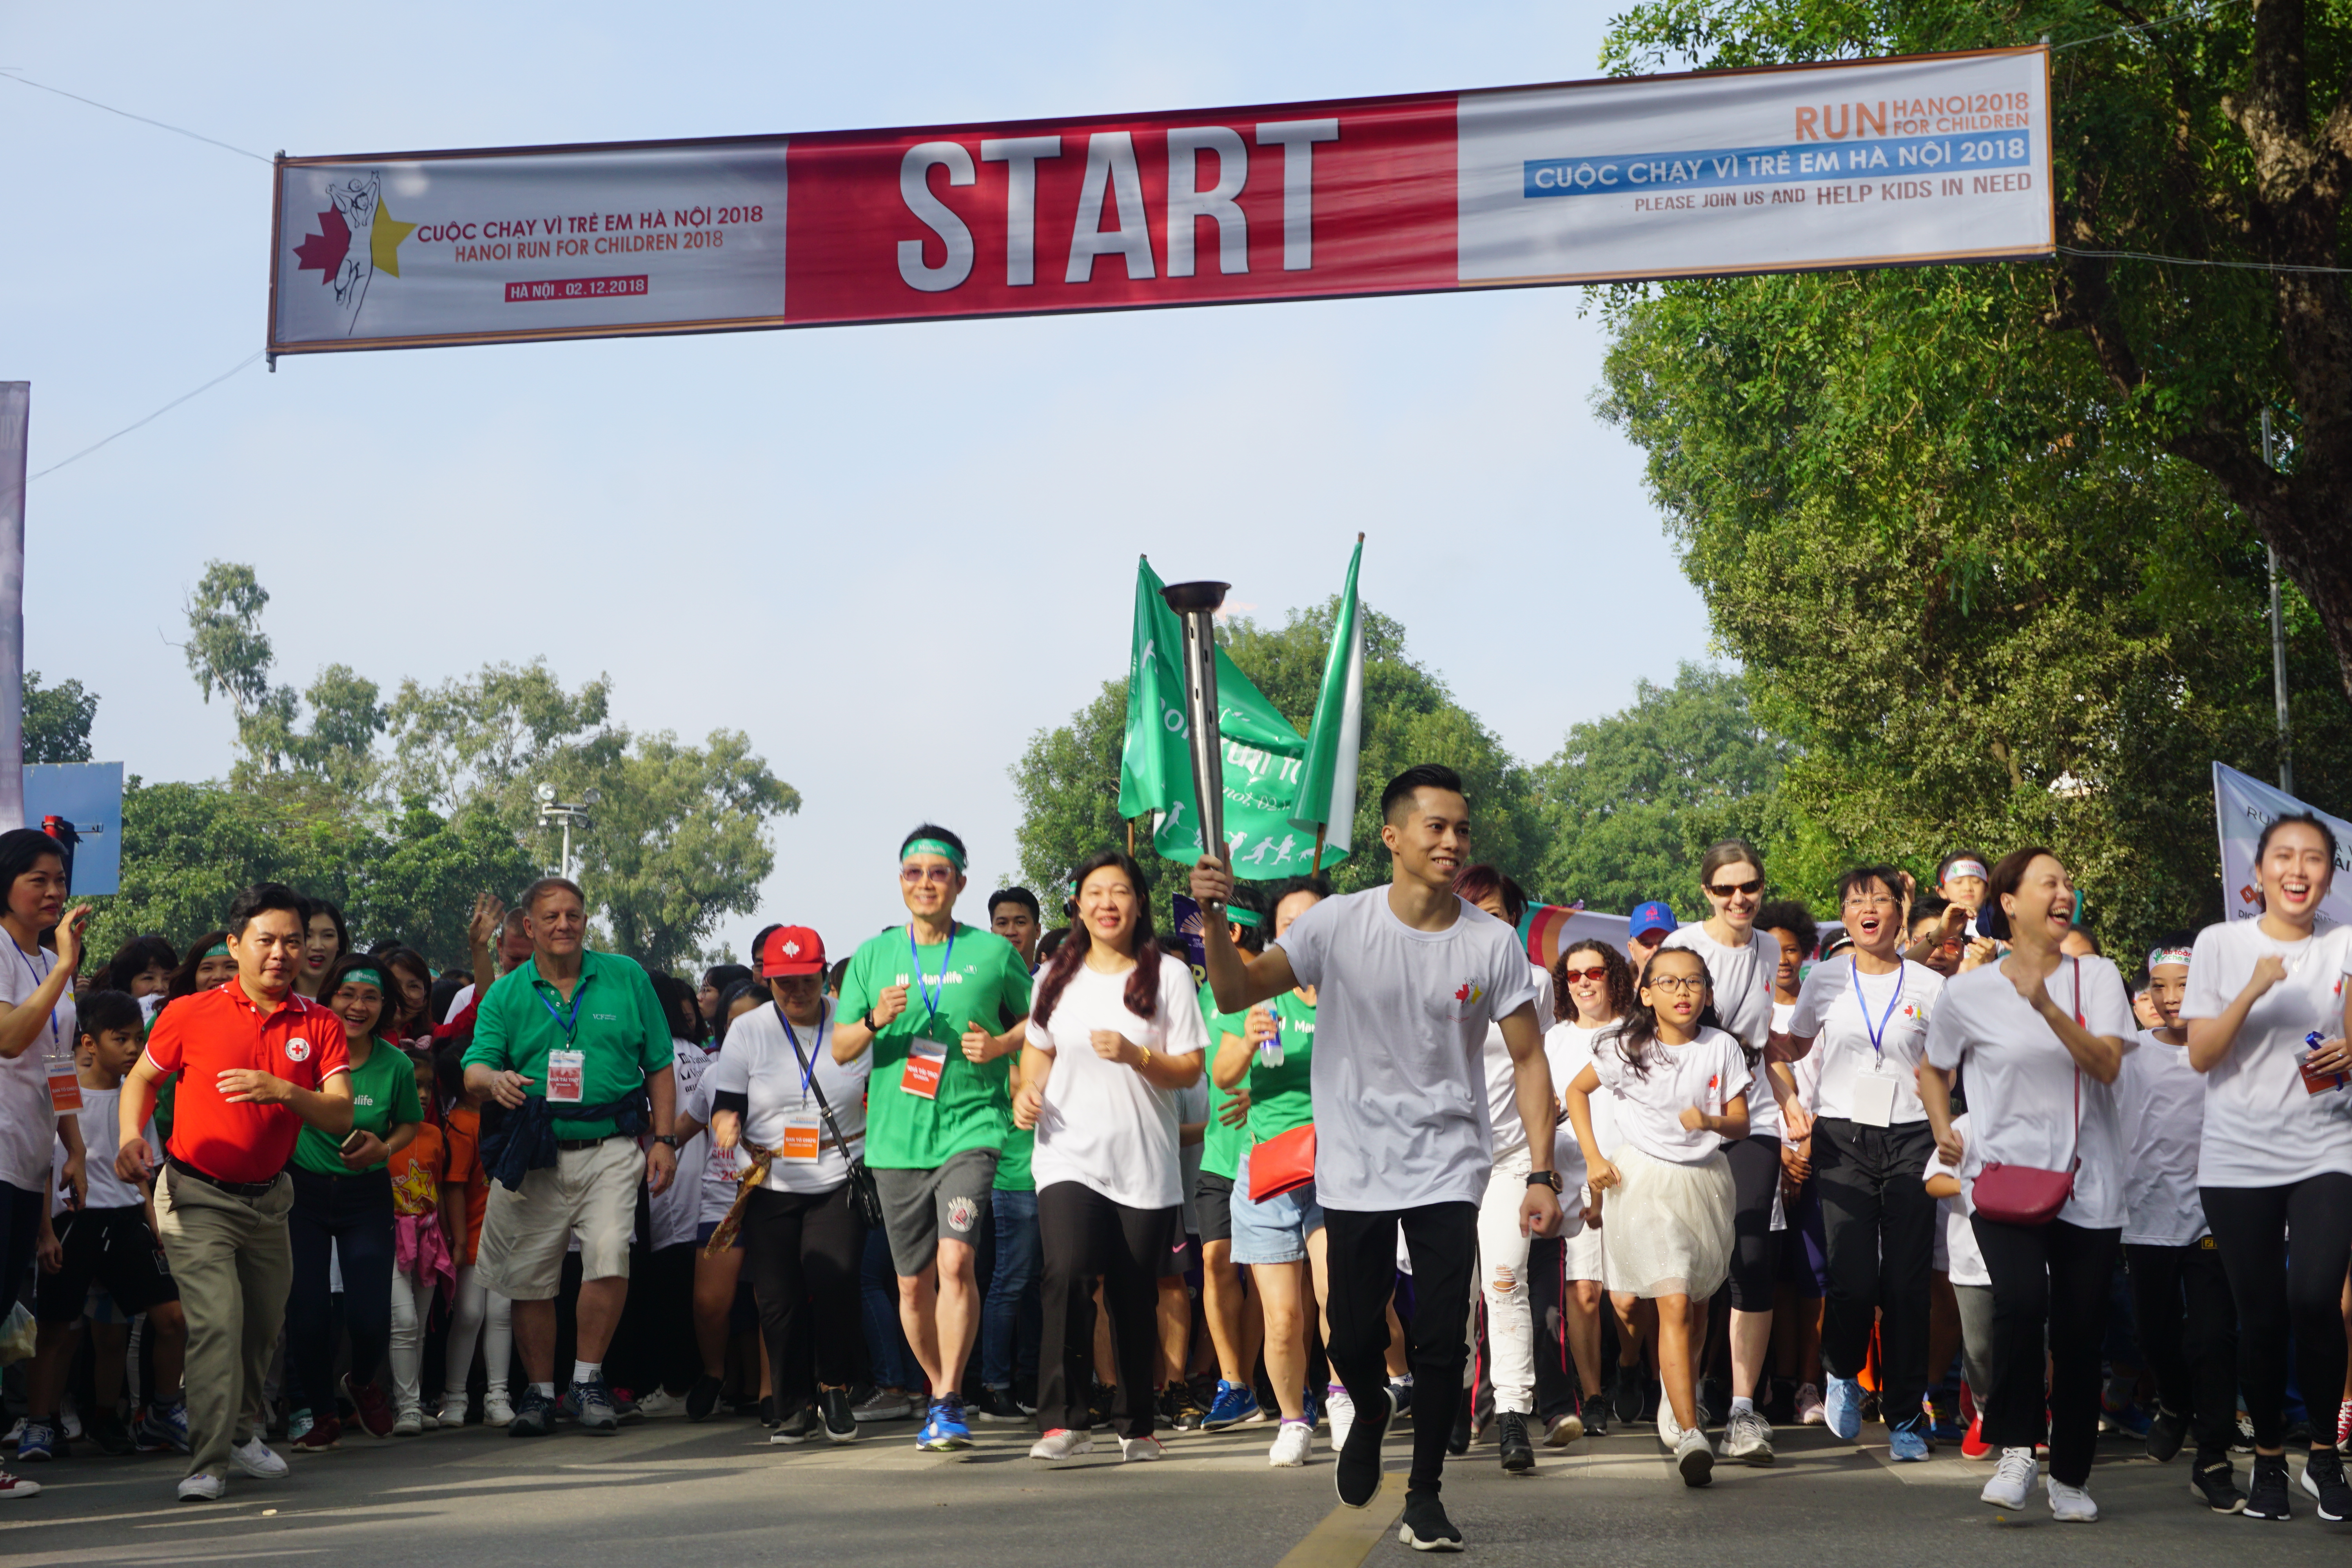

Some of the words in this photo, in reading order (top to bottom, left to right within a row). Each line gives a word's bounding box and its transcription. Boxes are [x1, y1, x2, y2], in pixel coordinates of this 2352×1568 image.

[1795, 101, 1886, 142] RUN
[1893, 120, 1929, 136] FOR
[1936, 112, 2029, 132] CHILDREN
[1535, 162, 1619, 189] CUỘC
[1628, 159, 1703, 184] CHẠY
[1712, 154, 1739, 178] VÌ
[1747, 150, 1790, 176] TRẺ
[1800, 151, 1840, 173] EM
[1850, 146, 1889, 170] HÀ
[1898, 141, 1951, 167] NỘI
[1960, 138, 2024, 163] 2018
[897, 118, 1339, 292] START
[1635, 195, 1695, 212] PLEASE
[1702, 192, 1736, 208] JOIN
[1744, 191, 1764, 205] US
[1771, 188, 1805, 204] AND
[1817, 184, 1872, 205] HELP
[1882, 180, 1932, 201] KIDS
[1942, 178, 1963, 196] IN
[1973, 173, 2031, 194] NEED
[417, 221, 476, 243] CUỘC
[483, 220, 537, 240] CHẠY
[544, 215, 561, 234] VÌ
[568, 212, 598, 233] TRẺ
[605, 214, 633, 231] EM
[640, 209, 667, 229] HÀ
[675, 206, 711, 228] NỘI
[717, 206, 763, 224] 2018
[456, 244, 510, 262] HANOI
[517, 241, 550, 259] RUN
[557, 239, 588, 256] FOR
[595, 233, 677, 254] CHILDREN
[683, 230, 723, 249] 2018
[511, 284, 528, 298] HÀ
[532, 282, 554, 299] NỘI
